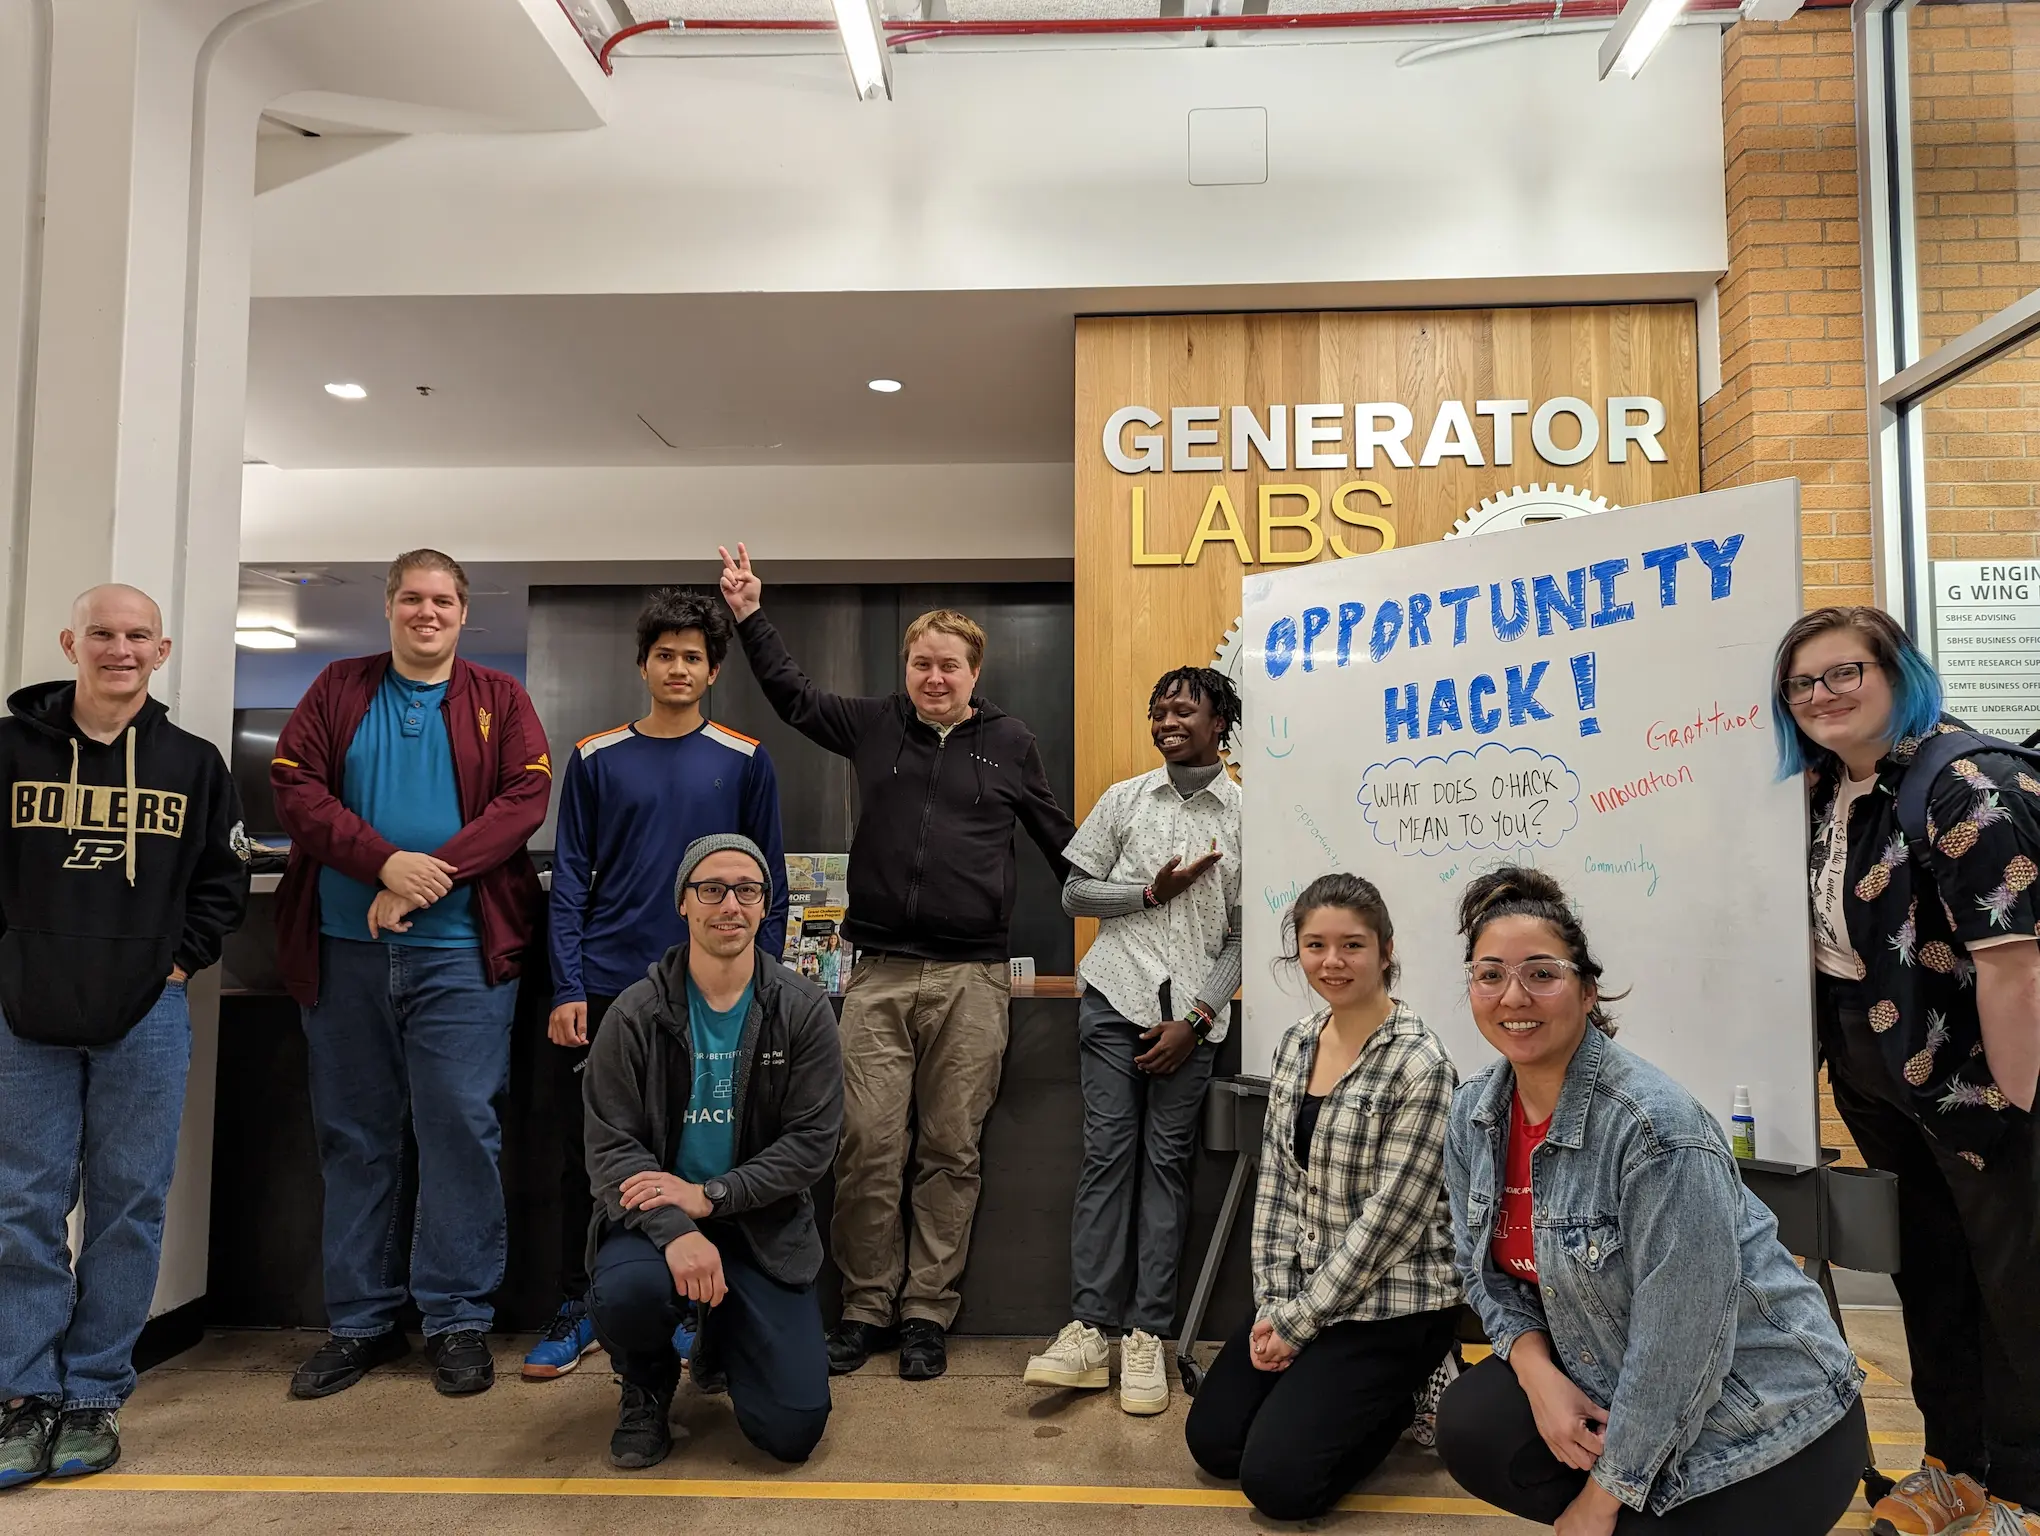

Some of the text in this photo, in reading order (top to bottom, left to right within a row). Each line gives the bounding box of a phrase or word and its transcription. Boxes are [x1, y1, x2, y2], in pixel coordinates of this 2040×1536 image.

[1102, 396, 1668, 473] GENERATOR
[1132, 481, 1396, 565] LABS
[1948, 585, 2029, 600] G WING
[1265, 534, 1744, 680] OPPORTUNITY
[1945, 614, 1972, 622] SBHSE
[1946, 637, 1974, 645] SBHSE
[1976, 636, 2016, 644] BUSINESS
[1947, 659, 1976, 667] SEMTE
[1978, 659, 2022, 667] RESEARCH
[1948, 682, 1977, 690] SEMTE
[1979, 682, 2020, 690] BUSINESS
[1949, 705, 1978, 713] SEMTE
[1373, 782, 1420, 808] WHAT
[1433, 777, 1477, 804] DOES
[16, 785, 182, 833] BOLERS
[1400, 816, 1448, 843] MEAN
[1458, 813, 1484, 836] TO
[683, 1107, 735, 1124] HACK
[1510, 1258, 1538, 1274] HA
